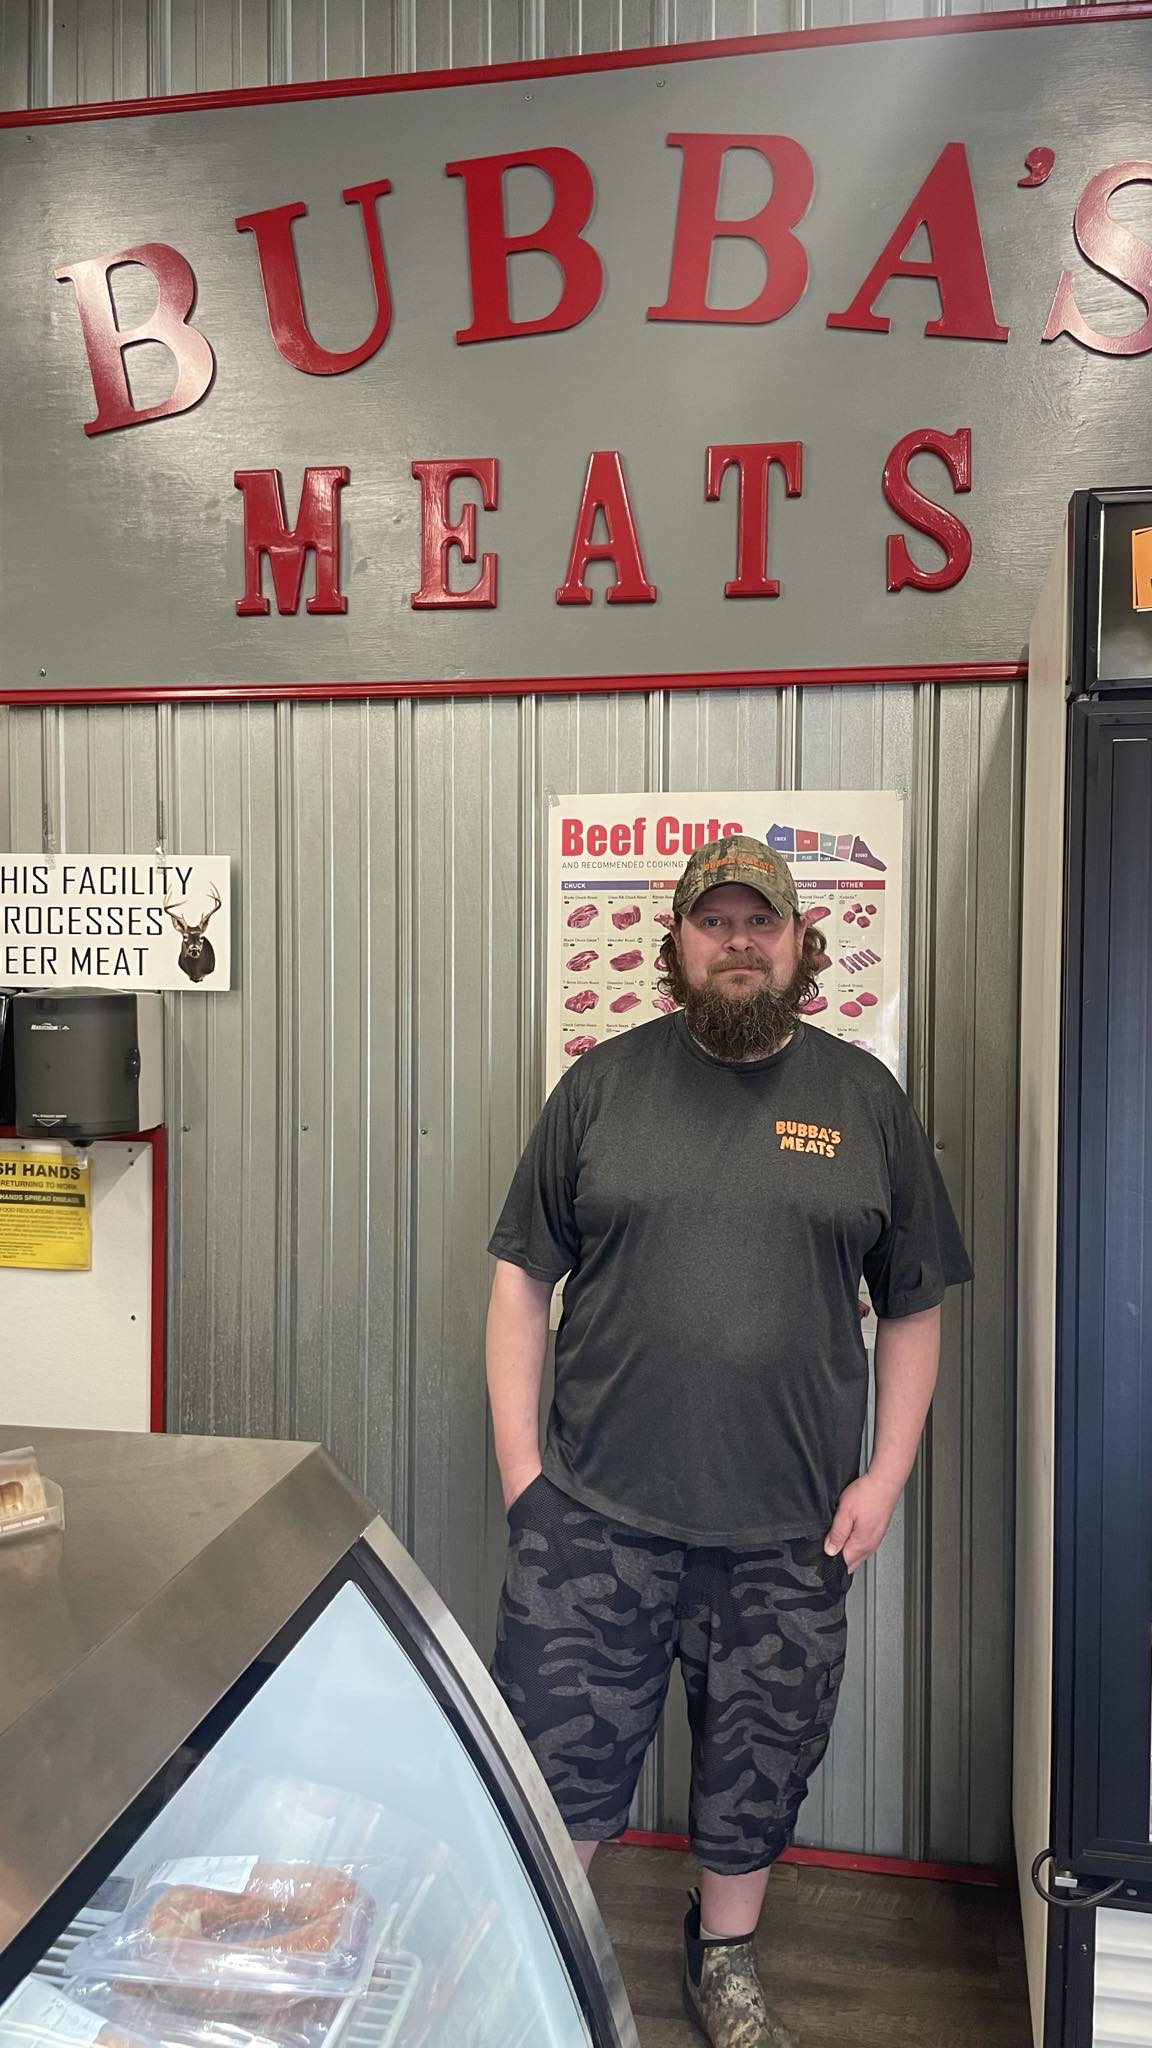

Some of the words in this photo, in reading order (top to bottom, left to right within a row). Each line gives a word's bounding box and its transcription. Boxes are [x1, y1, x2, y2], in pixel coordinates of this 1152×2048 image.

[54, 132, 1152, 437] BUBBA'S
[233, 427, 972, 616] MEATS
[562, 817, 646, 856] Beef
[561, 861, 579, 869] AND
[581, 861, 645, 869] RECOMMENDED
[646, 860, 684, 869] COOKING
[62, 866, 193, 895] FACILITY
[71, 946, 149, 976] MEAT
[775, 1120, 842, 1144] BUBBA'S
[780, 1136, 836, 1158] MEATS
[23, 1163, 81, 1180] HANDS
[1, 1180, 44, 1188] RETURNING
[24, 1194, 52, 1202] SPREAD
